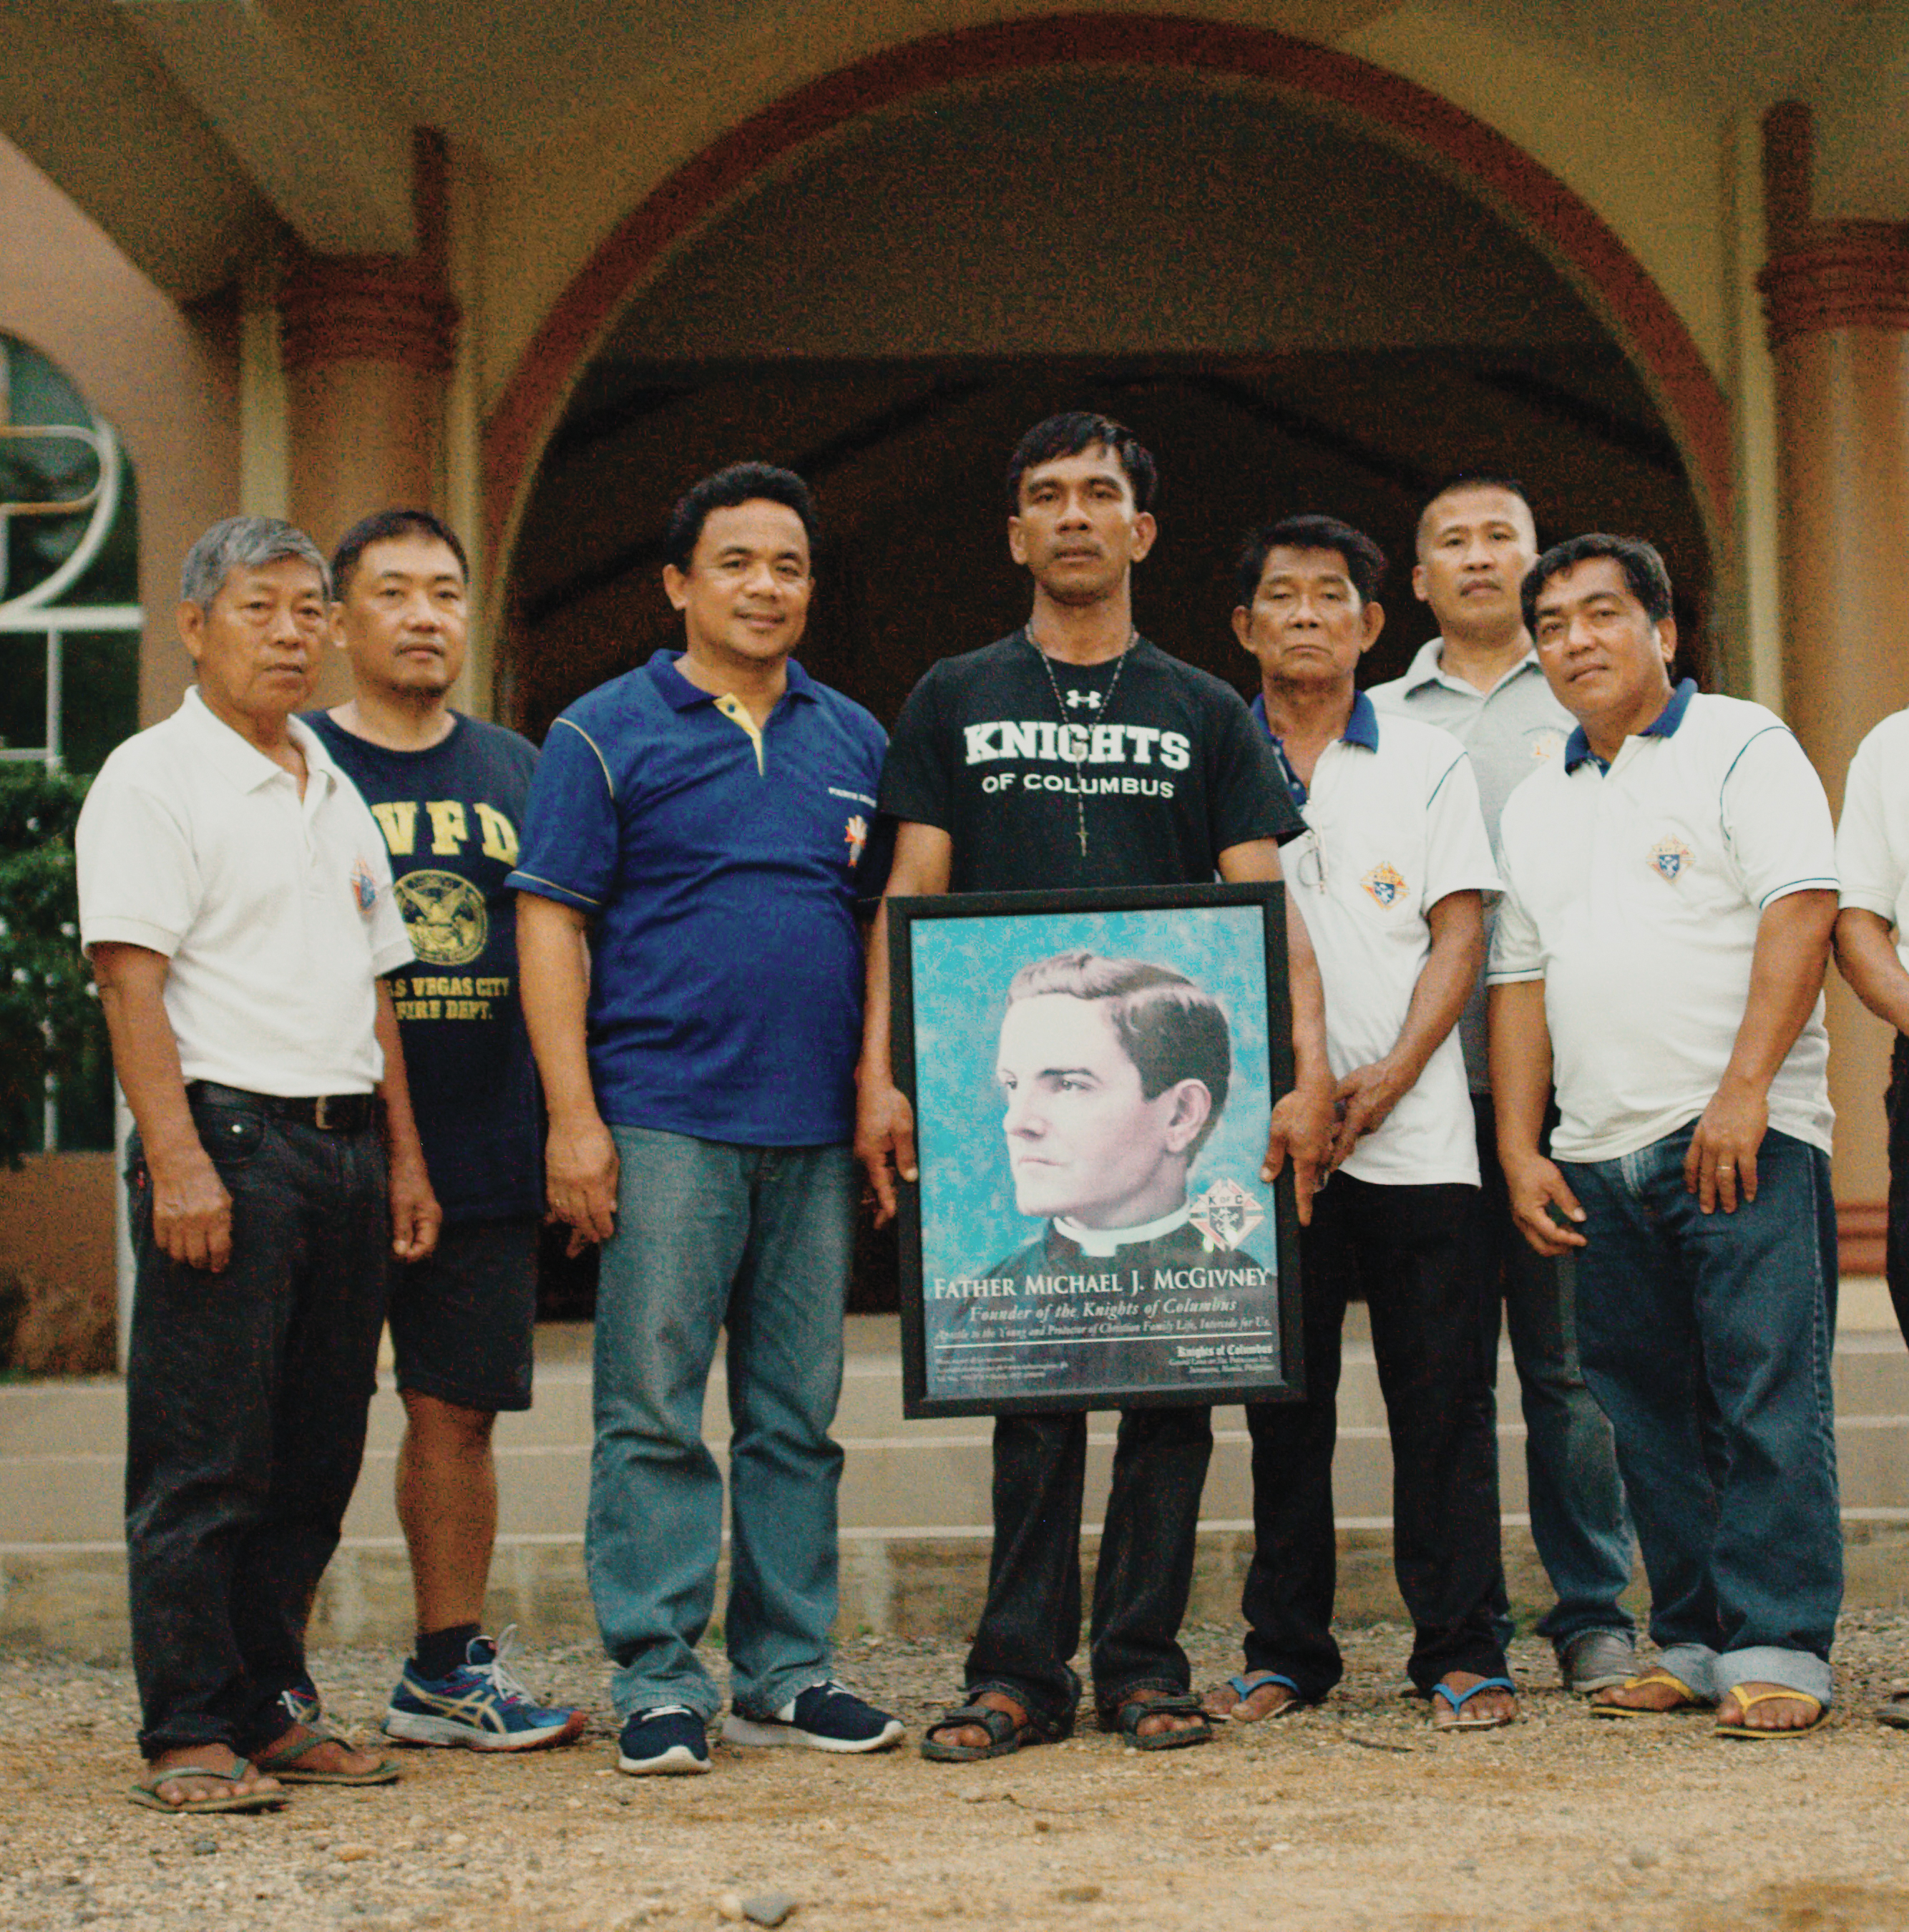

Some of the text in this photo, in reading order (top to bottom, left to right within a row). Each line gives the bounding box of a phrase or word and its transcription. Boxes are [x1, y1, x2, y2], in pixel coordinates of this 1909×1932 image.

[963, 721, 1191, 771] KNIGHTS
[982, 774, 1175, 799] OF COLUMBUS
[411, 977, 474, 997] VEGAS
[475, 977, 509, 997] CITY
[395, 1000, 493, 1020] FIRE DEPT.
[934, 1278, 1017, 1299] FATHER
[1025, 1273, 1123, 1295] MICHAEL
[1131, 1269, 1145, 1297] J.
[970, 1297, 1238, 1323] Founder of the Knights of Columbus
